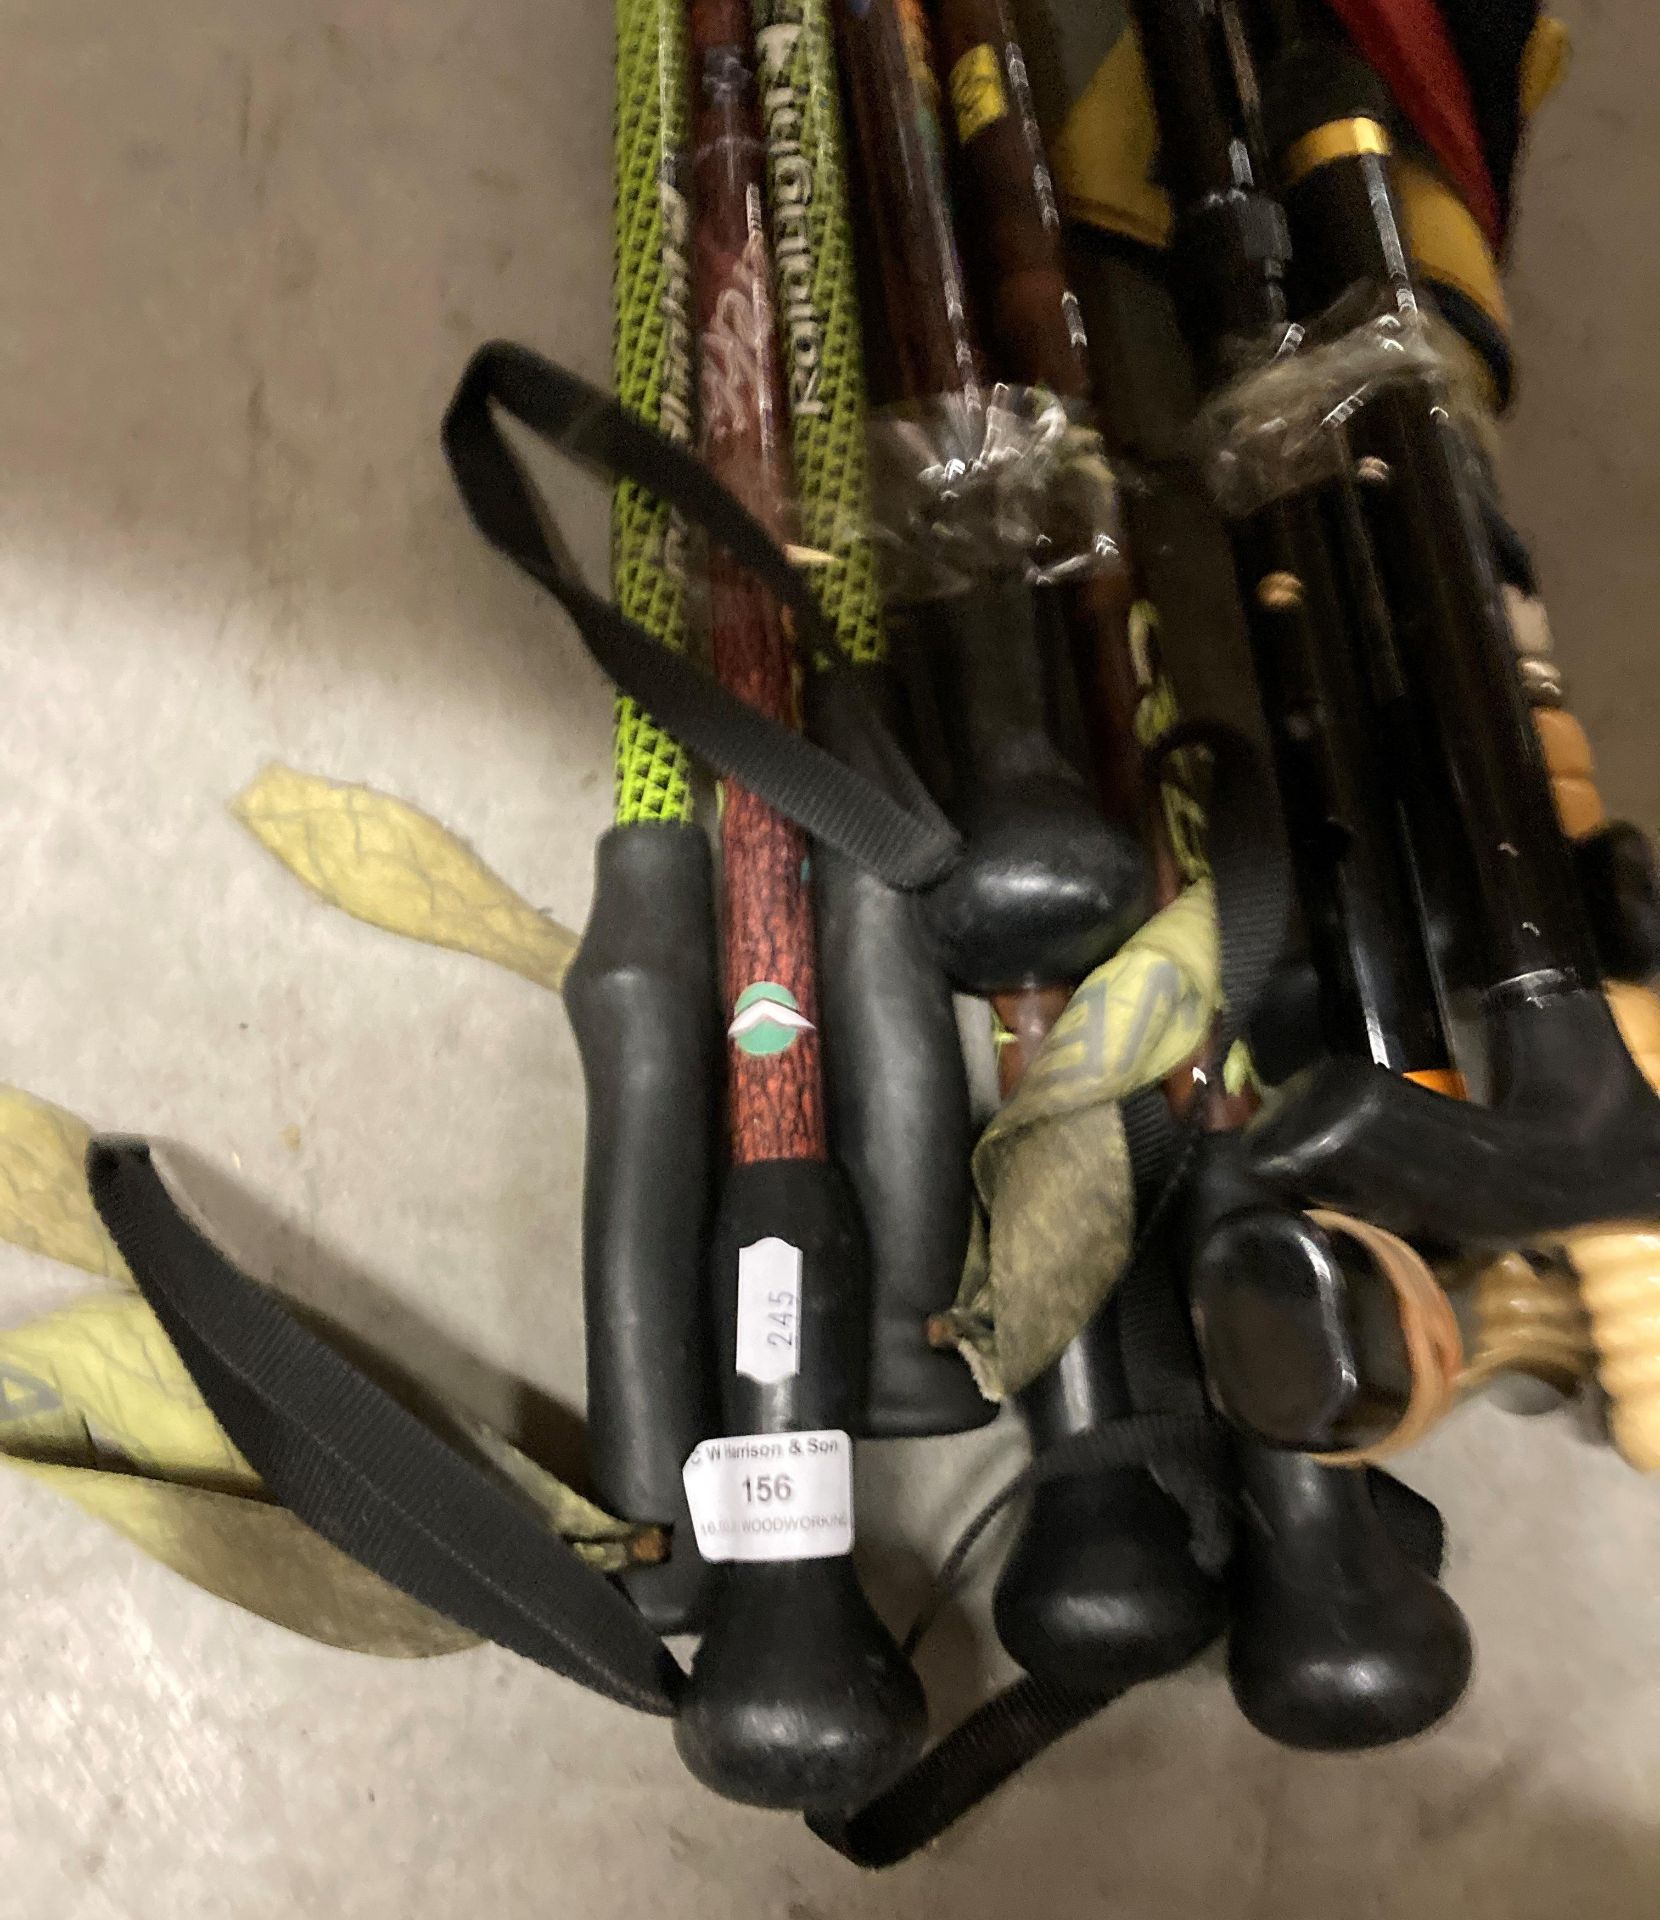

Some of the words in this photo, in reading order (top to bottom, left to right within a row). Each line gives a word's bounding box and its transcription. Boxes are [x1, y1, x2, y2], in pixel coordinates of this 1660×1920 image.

[767, 1290, 794, 1346] 245
[706, 1444, 721, 1461] W
[788, 1438, 802, 1455] &
[807, 1437, 838, 1453] Son
[742, 1473, 792, 1502] 156
